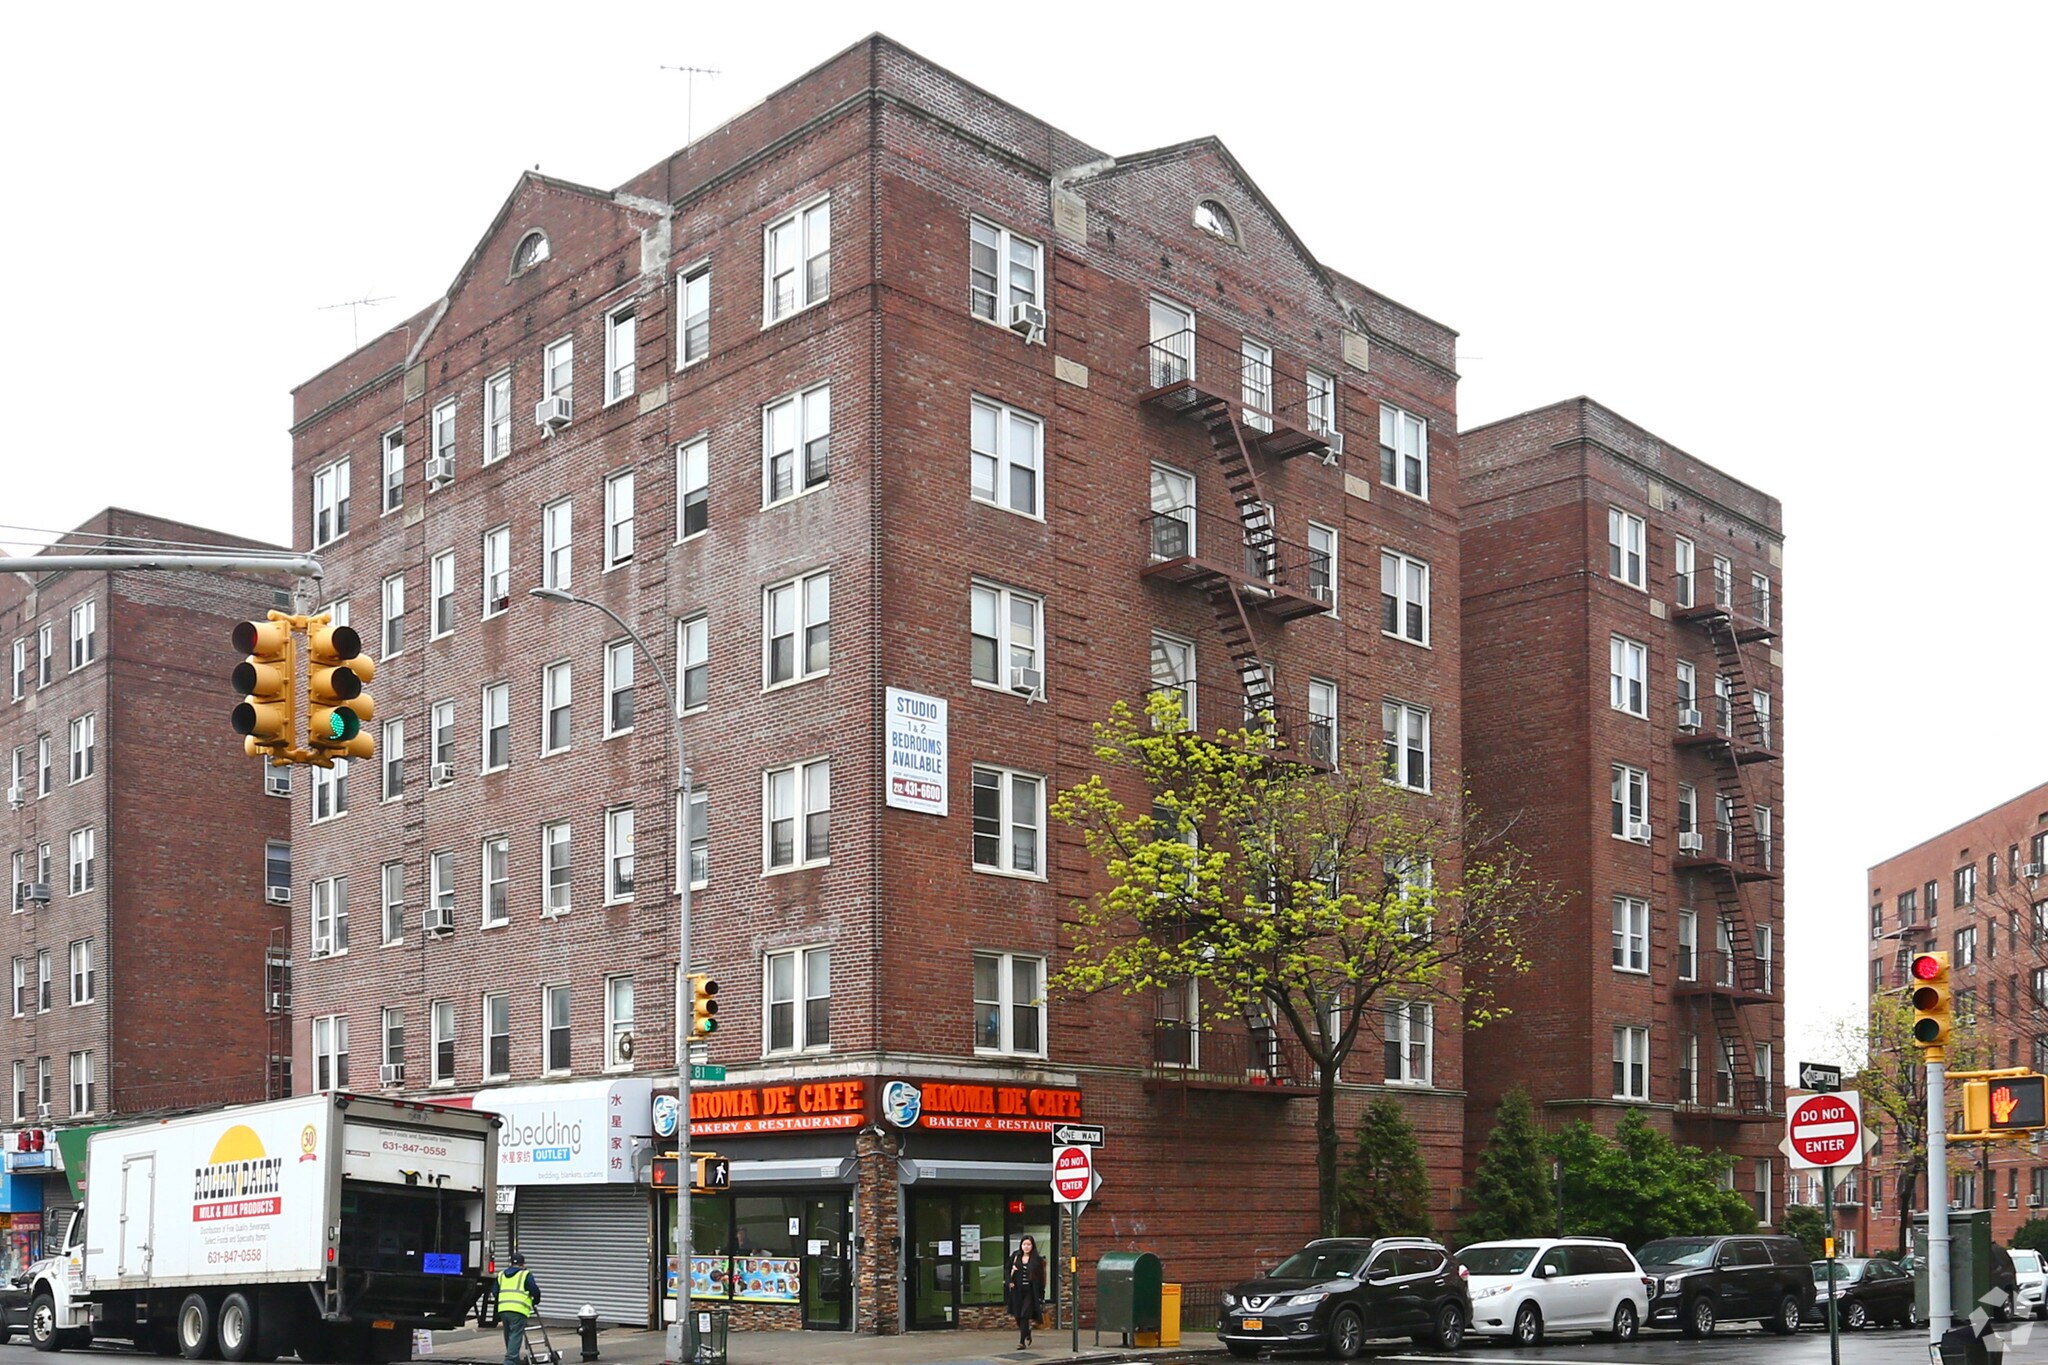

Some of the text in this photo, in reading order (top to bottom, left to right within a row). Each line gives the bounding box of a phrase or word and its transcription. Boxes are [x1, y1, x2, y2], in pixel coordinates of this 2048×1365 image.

[897, 696, 937, 719] STUDIO
[914, 725, 918, 733] &
[921, 724, 927, 734] 2
[892, 731, 942, 756] BEDROOMS
[892, 750, 942, 774] AVAILABLE
[904, 781, 940, 801] 431-6600
[694, 1066, 722, 1079] 81 ST
[1805, 1071, 1837, 1084] ONE WAY
[762, 1086, 795, 1115] DE
[800, 1081, 864, 1113] CAFE
[921, 1083, 1082, 1118] AROMA DE CAFE
[1800, 1107, 1846, 1122] DO NOT
[744, 1120, 752, 1131] &
[758, 1115, 853, 1130] RESTAURANT
[929, 1116, 1052, 1131] BAKERY & RESTAUR
[304, 1131, 313, 1147] 30
[611, 1093, 623, 1170] 水星家纺
[1060, 1131, 1098, 1141] ONE WAY
[382, 1140, 447, 1157] 631-847-0558
[535, 1148, 568, 1160] OUTLET
[1805, 1139, 1845, 1153] ENTER
[501, 1151, 531, 1163] 水星家纺
[1060, 1156, 1084, 1167] DO NOT
[241, 1157, 282, 1196] DAIRY
[1062, 1180, 1083, 1191] ENTER
[199, 1199, 275, 1219] MILK & MILK PRODUCTS
[791, 1220, 798, 1230] A
[207, 1248, 262, 1264] 631-847-0558
